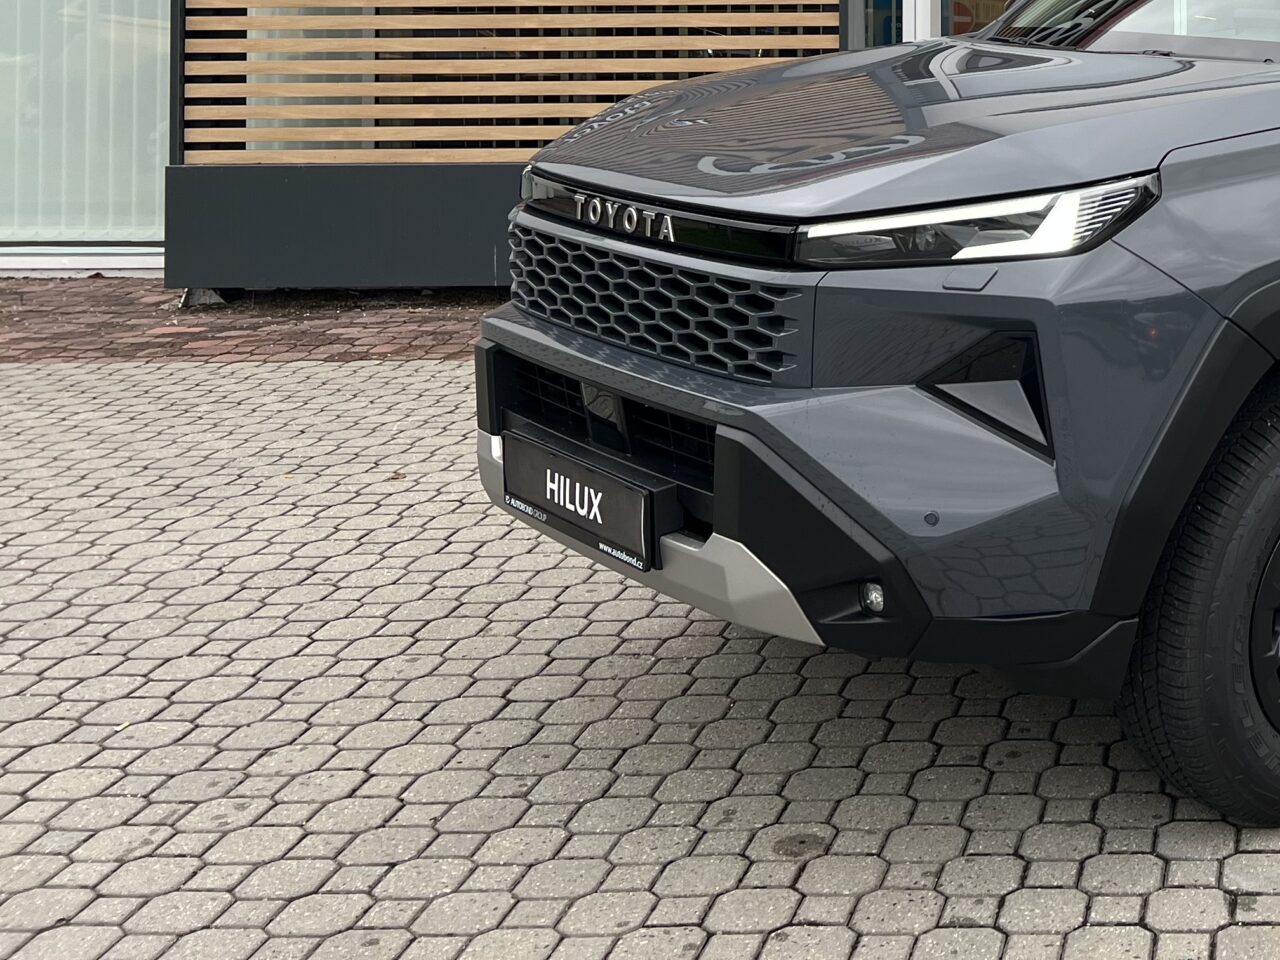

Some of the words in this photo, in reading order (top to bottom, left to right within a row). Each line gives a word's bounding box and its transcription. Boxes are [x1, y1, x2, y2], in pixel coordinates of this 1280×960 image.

[573, 192, 675, 243] TOYOTA
[510, 497, 534, 516] AUTOBOND
[546, 468, 603, 525] HILUX
[598, 542, 644, 570] www.autobond.cz
